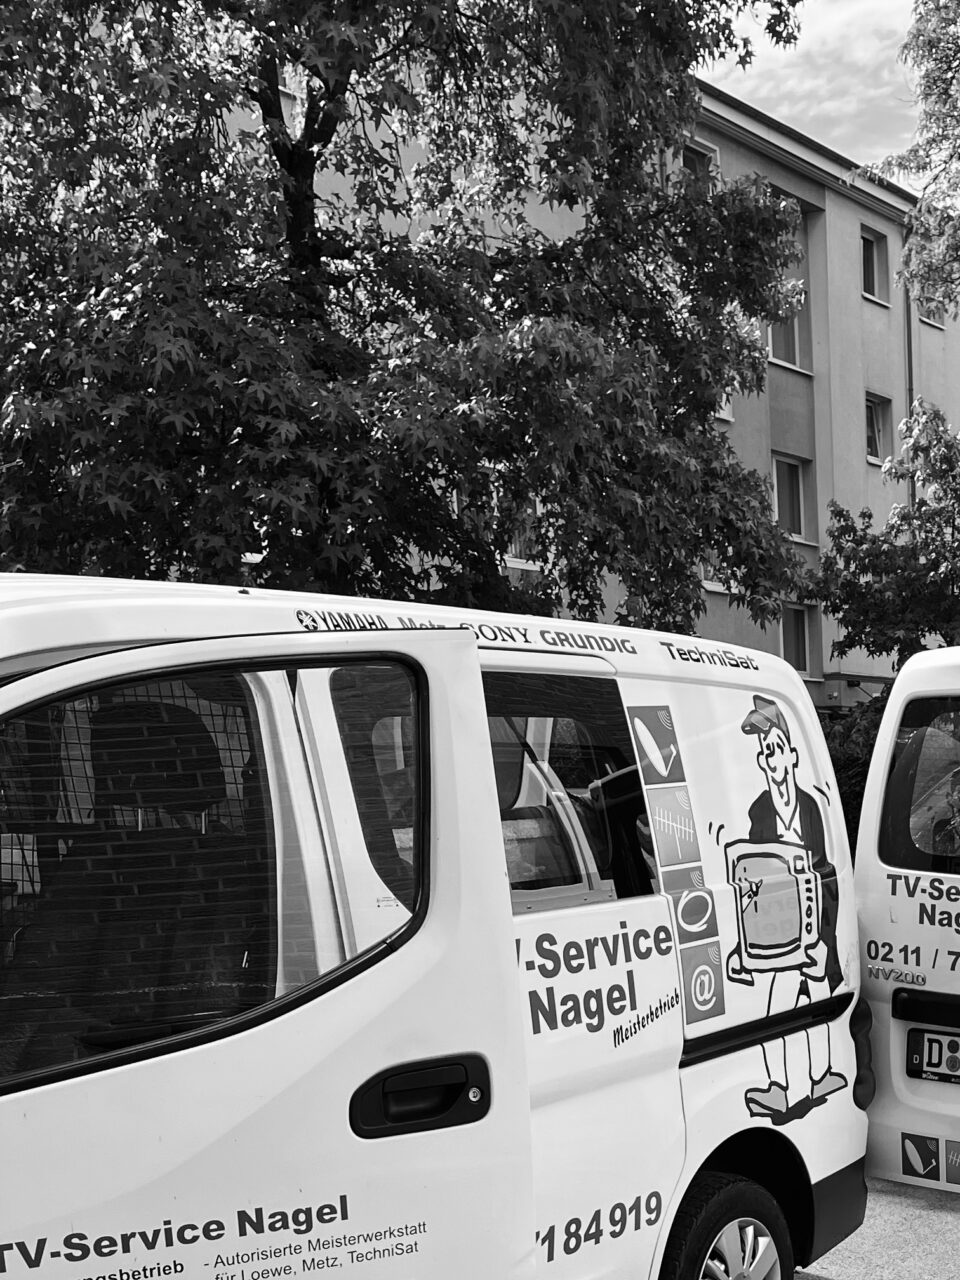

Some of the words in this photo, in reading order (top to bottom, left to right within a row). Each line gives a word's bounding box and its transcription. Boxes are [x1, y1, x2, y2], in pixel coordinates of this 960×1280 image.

[315, 610, 389, 630] YAMAHA
[460, 623, 532, 643] SONY
[540, 629, 638, 655] GRUNDIG
[659, 641, 759, 671] TechniSat
[515, 920, 673, 979] -Service
[866, 940, 921, 967] 0211
[867, 964, 927, 986] NV200
[528, 969, 638, 1035] Nagel
[612, 987, 680, 1048] Meisterbetrieb
[236, 1194, 349, 1238] Nagel
[213, 1243, 303, 1269] Autorisierte
[307, 1221, 427, 1252] Meisterwerkstatt
[302, 1256, 343, 1272] Metz,
[347, 1241, 419, 1264] TechniSat
